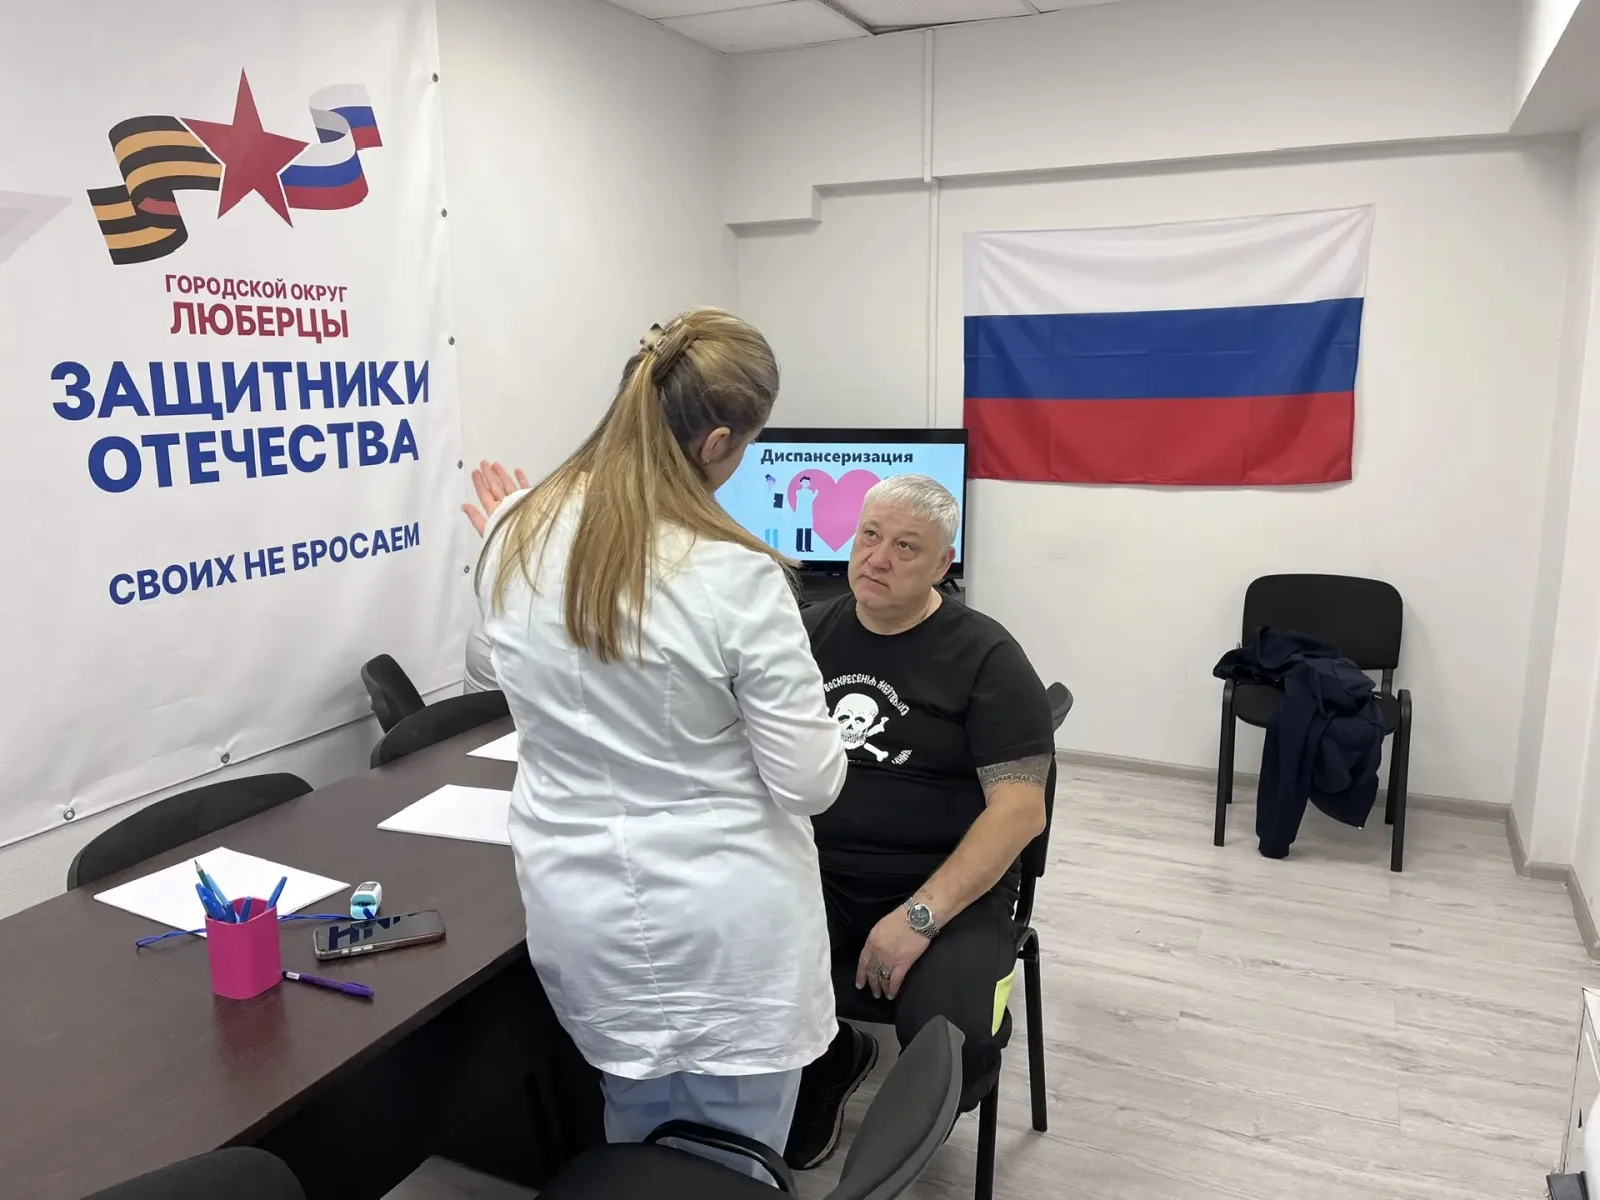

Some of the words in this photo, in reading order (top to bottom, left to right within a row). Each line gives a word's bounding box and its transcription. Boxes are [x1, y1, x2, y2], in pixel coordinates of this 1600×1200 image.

[165, 274, 286, 299] ГОРОДСКОЙ
[291, 283, 348, 302] ОКРУГ
[170, 301, 349, 344] ЛЮБЕРЦЫ
[50, 360, 429, 421] ЗАЩИТНИКИ
[87, 418, 420, 493] ОТЕЧЕСТВА
[761, 449, 913, 466] Диспансеризация
[108, 554, 237, 605] СВОИХ
[244, 545, 285, 579] НЕ
[292, 522, 420, 571] БРОСАЕМ
